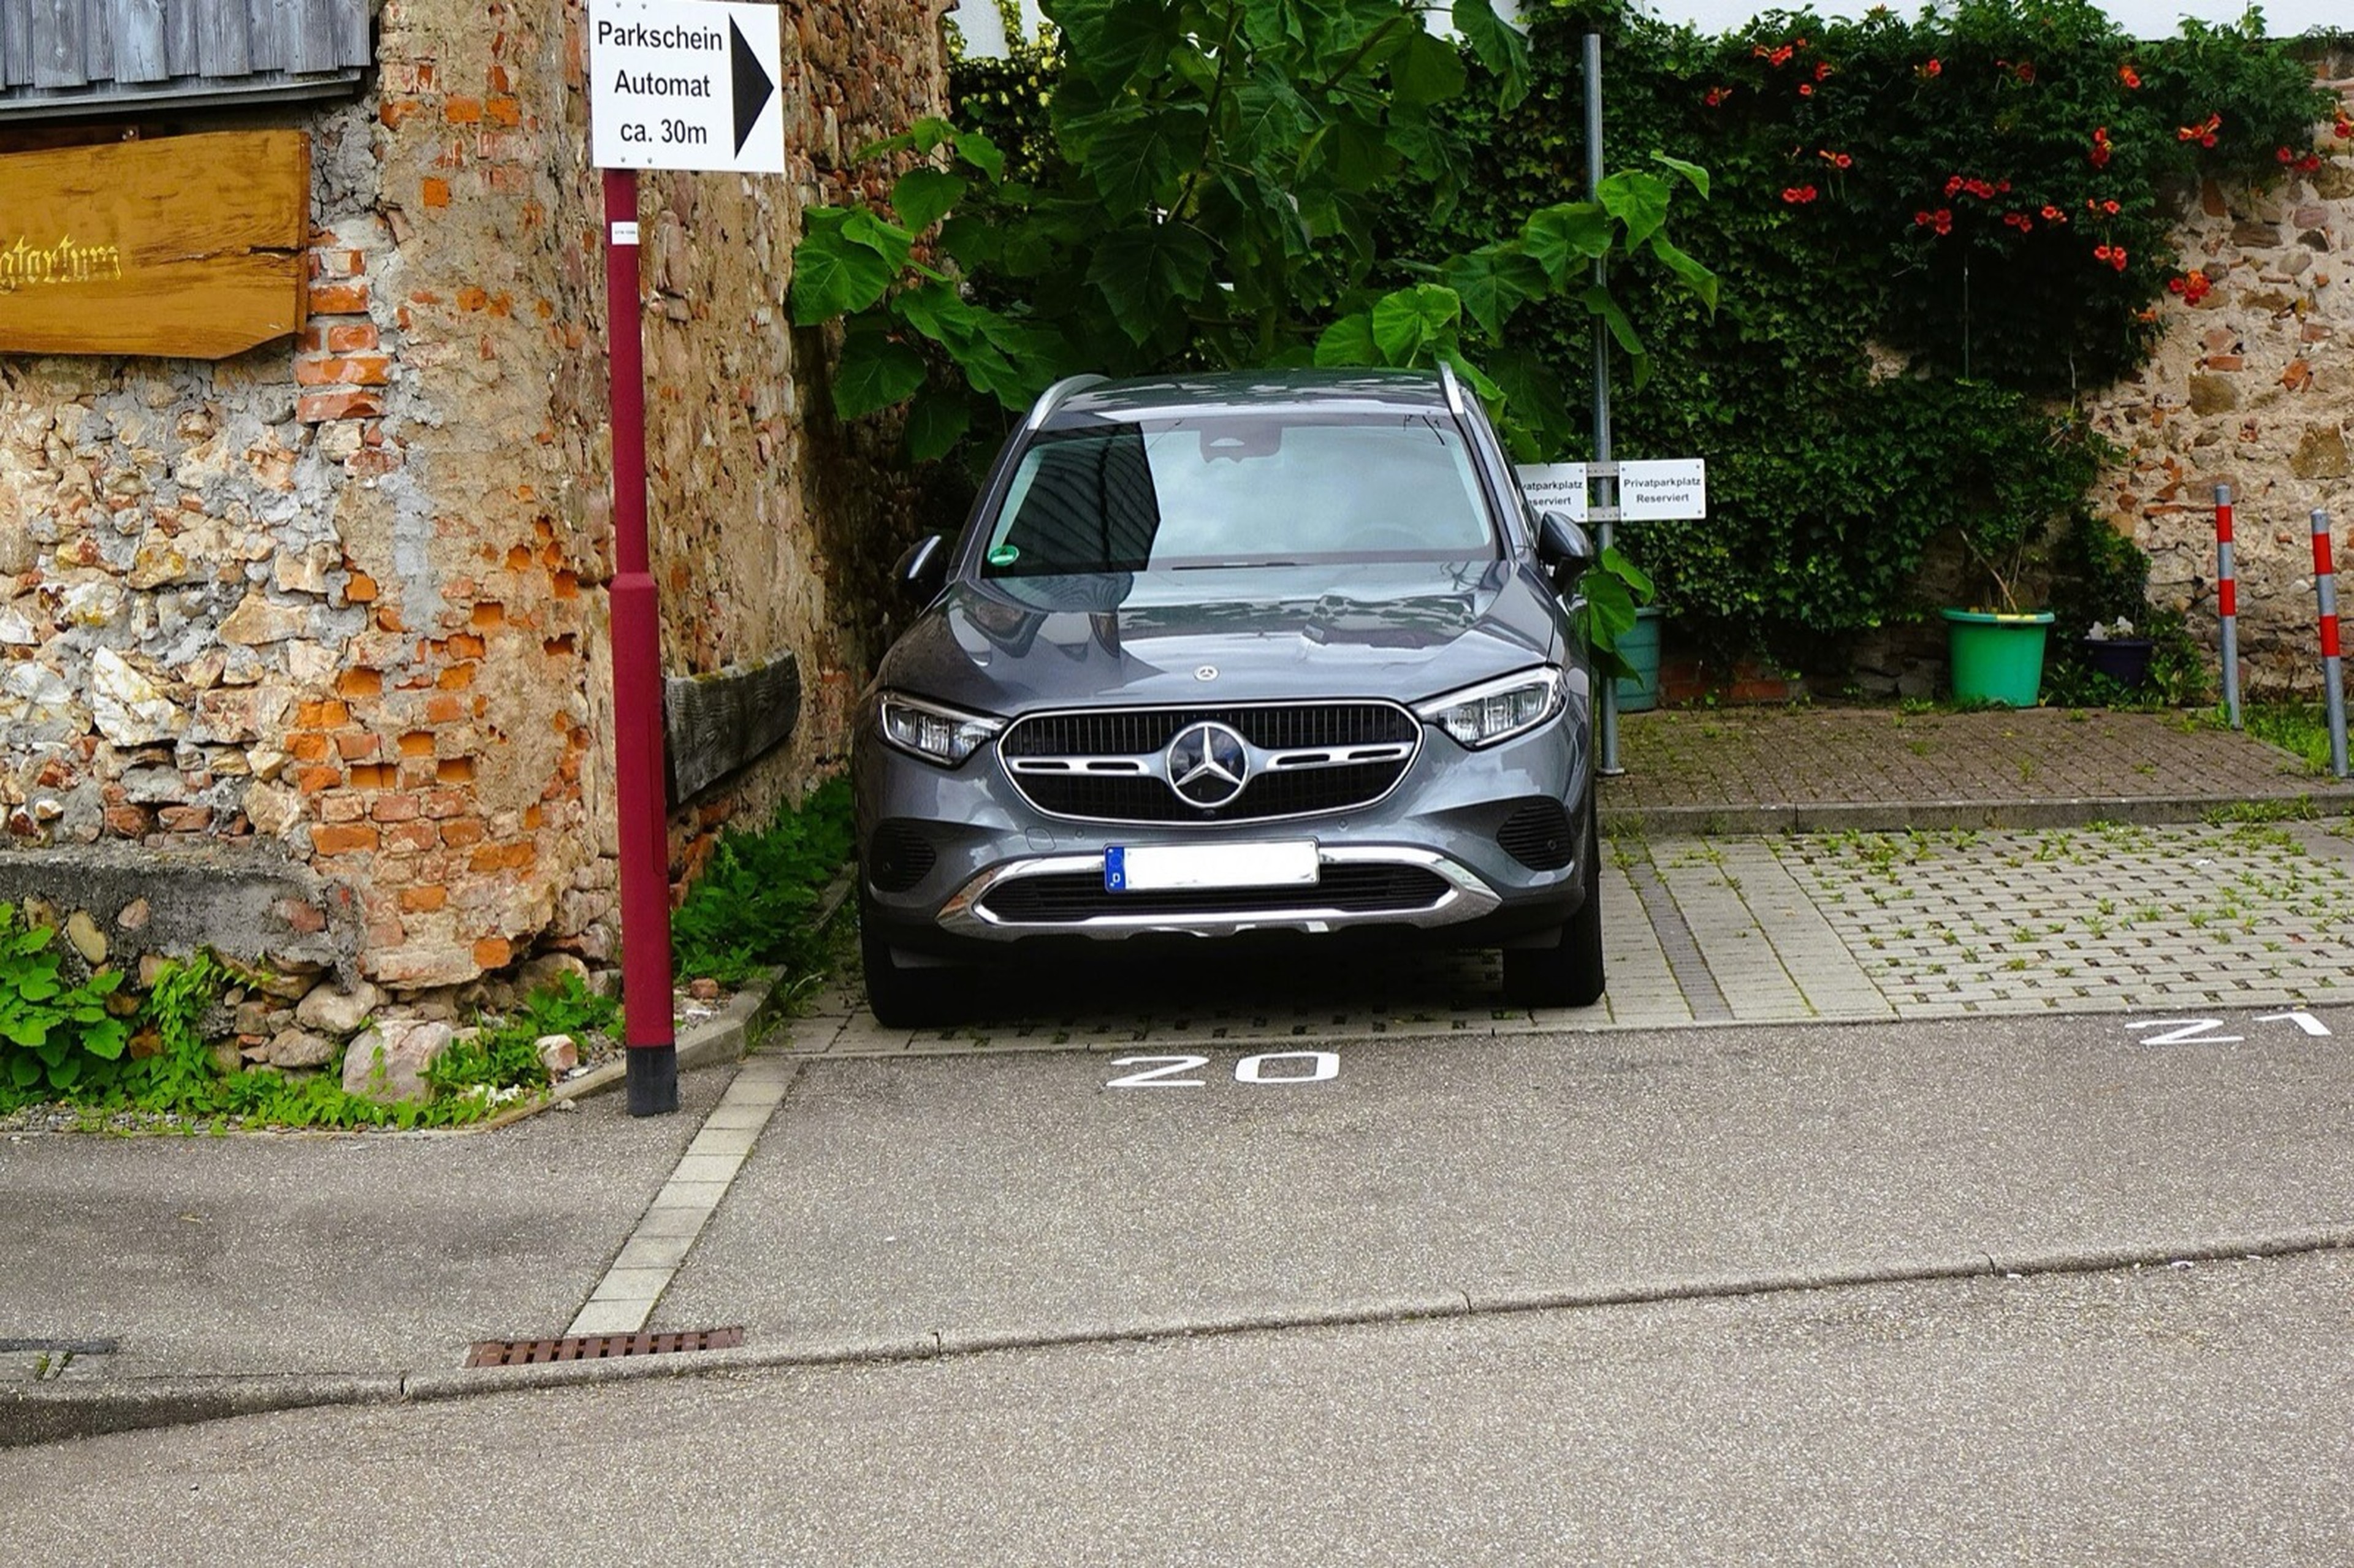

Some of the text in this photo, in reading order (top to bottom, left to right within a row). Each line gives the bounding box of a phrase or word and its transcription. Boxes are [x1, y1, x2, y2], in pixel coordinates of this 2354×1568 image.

[598, 20, 723, 51] Parkschein
[614, 69, 710, 97] Automat
[620, 118, 707, 144] ca. 30m
[1623, 478, 1701, 489] Privatparkplatz
[1636, 493, 1689, 503] Reserviert
[1112, 872, 1121, 883] D
[2124, 1012, 2332, 1045] 21
[1105, 1051, 1340, 1087] 20
